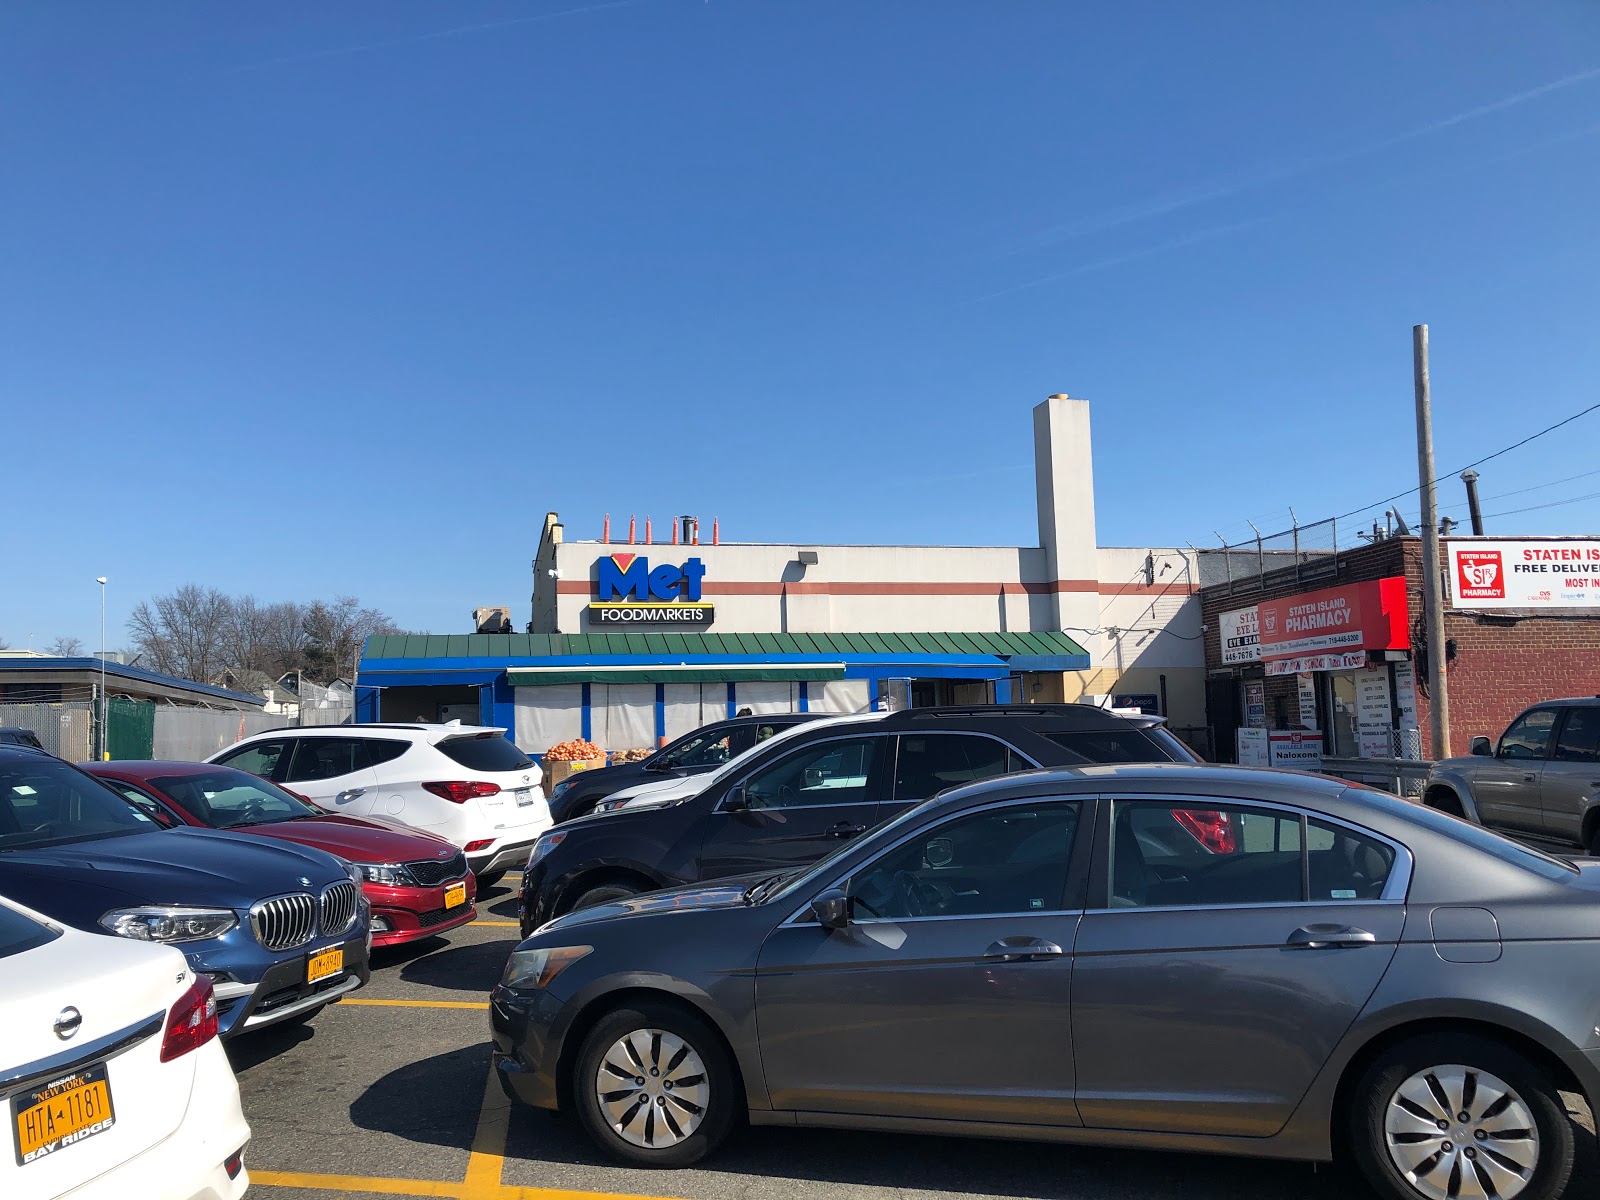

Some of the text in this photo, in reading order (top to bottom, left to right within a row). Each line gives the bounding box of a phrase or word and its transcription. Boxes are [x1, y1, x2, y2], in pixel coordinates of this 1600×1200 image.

[1523, 549, 1581, 561] STATEN
[1514, 564, 1600, 573] FREE DELIVE
[598, 553, 706, 600] Met
[1565, 578, 1589, 588] MOST
[1462, 588, 1502, 597] PHARMACY
[1289, 597, 1346, 617] STATEN ISLAND
[601, 608, 704, 621] FOODMARKETS
[1285, 607, 1352, 634] PHARMACY
[1236, 624, 1251, 636] EYE
[1228, 638, 1241, 648] EYE
[1225, 650, 1252, 662] 448-7676
[47, 1073, 76, 1090] NISSAN
[37, 1076, 86, 1102] NEW YORK
[26, 1086, 102, 1144] HTA 1181
[24, 1117, 113, 1164] BAY RIDGE
